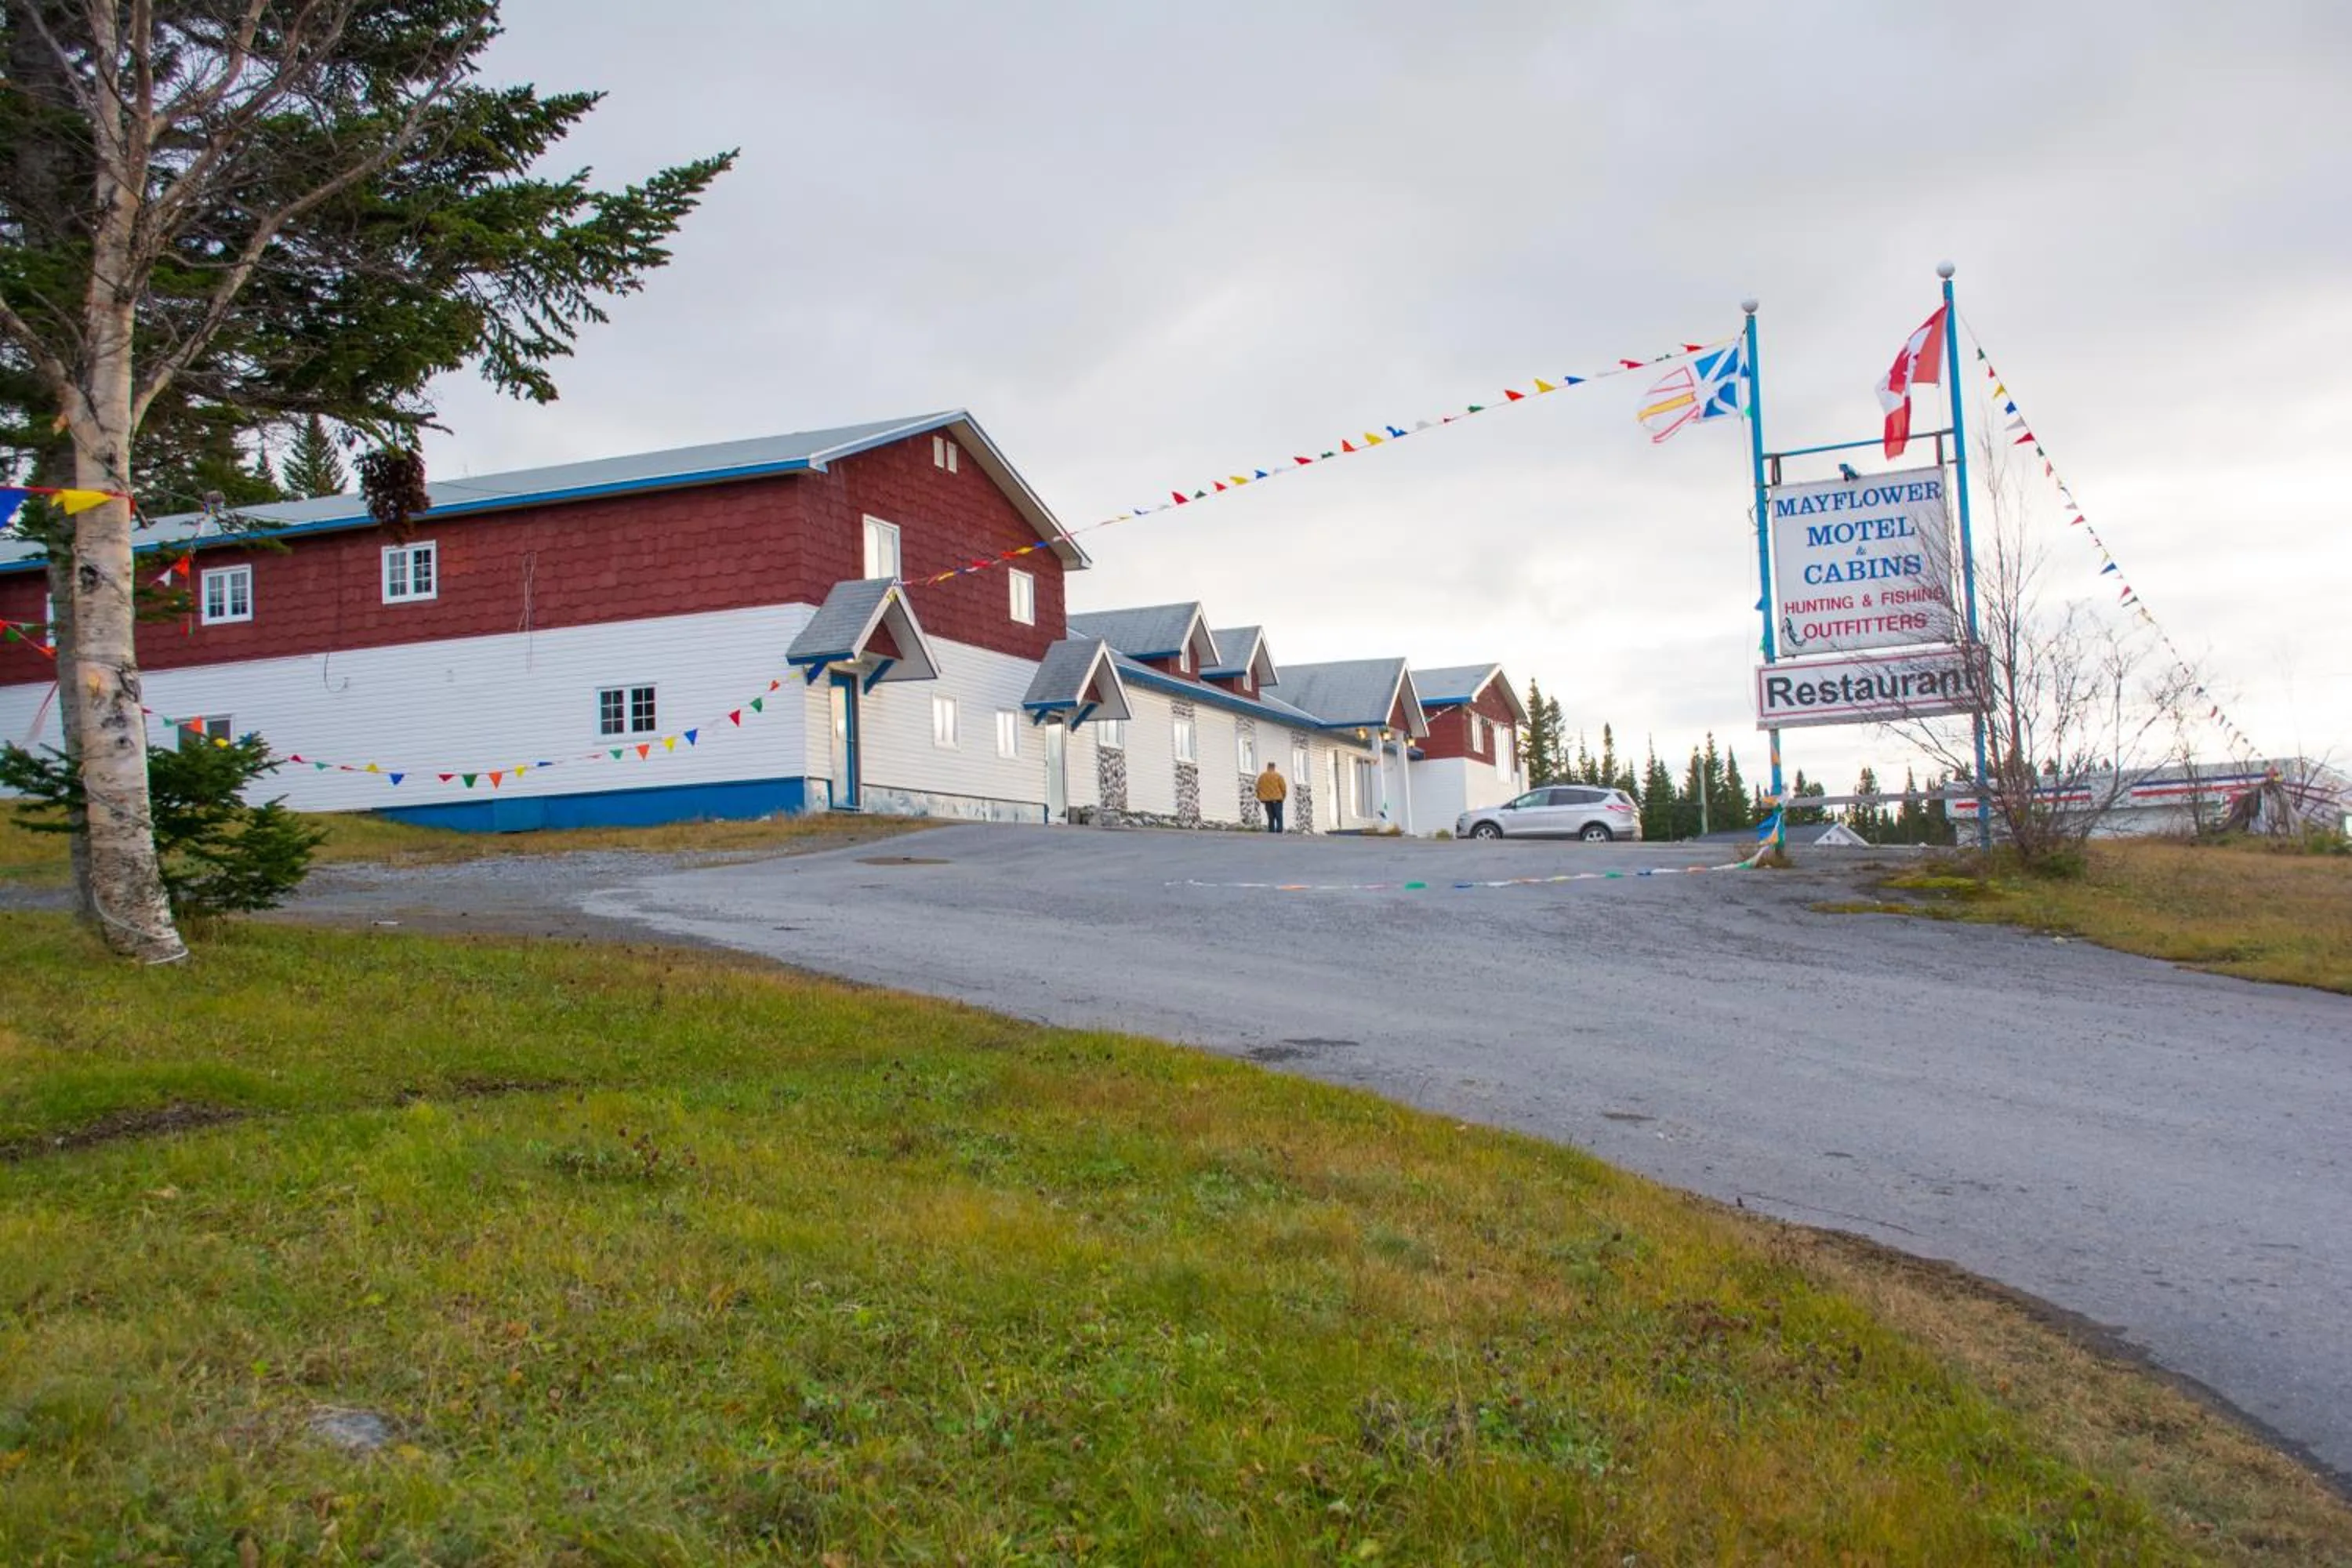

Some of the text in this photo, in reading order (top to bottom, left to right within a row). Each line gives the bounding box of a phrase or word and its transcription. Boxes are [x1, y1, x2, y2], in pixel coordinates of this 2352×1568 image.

[1776, 481, 1943, 517] MAYFLOWER
[1806, 517, 1915, 547] MOTEL
[1856, 546, 1866, 555] &
[1804, 554, 1922, 585] CABINS
[1784, 586, 1945, 615] HUNTING & FISHING
[1803, 612, 1928, 640] OUTFITTERS
